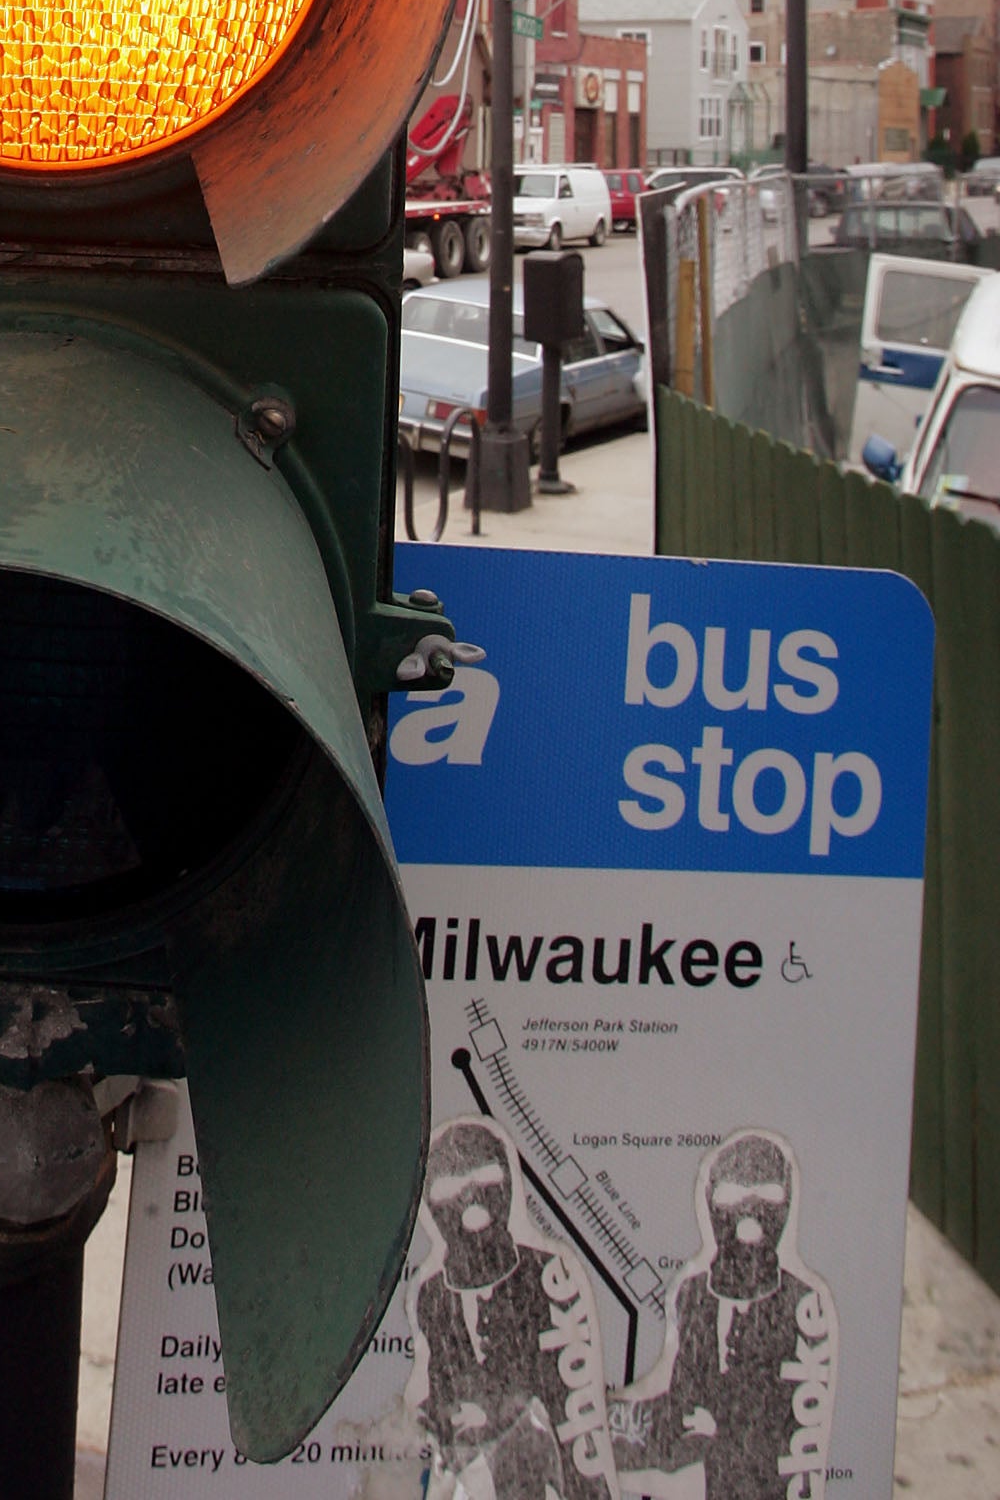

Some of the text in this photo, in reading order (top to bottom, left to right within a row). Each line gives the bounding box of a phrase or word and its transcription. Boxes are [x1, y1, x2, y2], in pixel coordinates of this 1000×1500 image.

[623, 592, 840, 715] bus
[617, 726, 883, 857] stop
[521, 1017, 679, 1034] Jefferson Park Station
[572, 1132, 722, 1149] Logan Square 2600N
[595, 1169, 642, 1231] Blue Line
[170, 1226, 206, 1249] Do
[160, 1334, 224, 1363] Daily
[539, 1255, 604, 1478] choke
[156, 1371, 205, 1395] late
[150, 1445, 225, 1473] Every
[291, 1442, 321, 1464] 20
